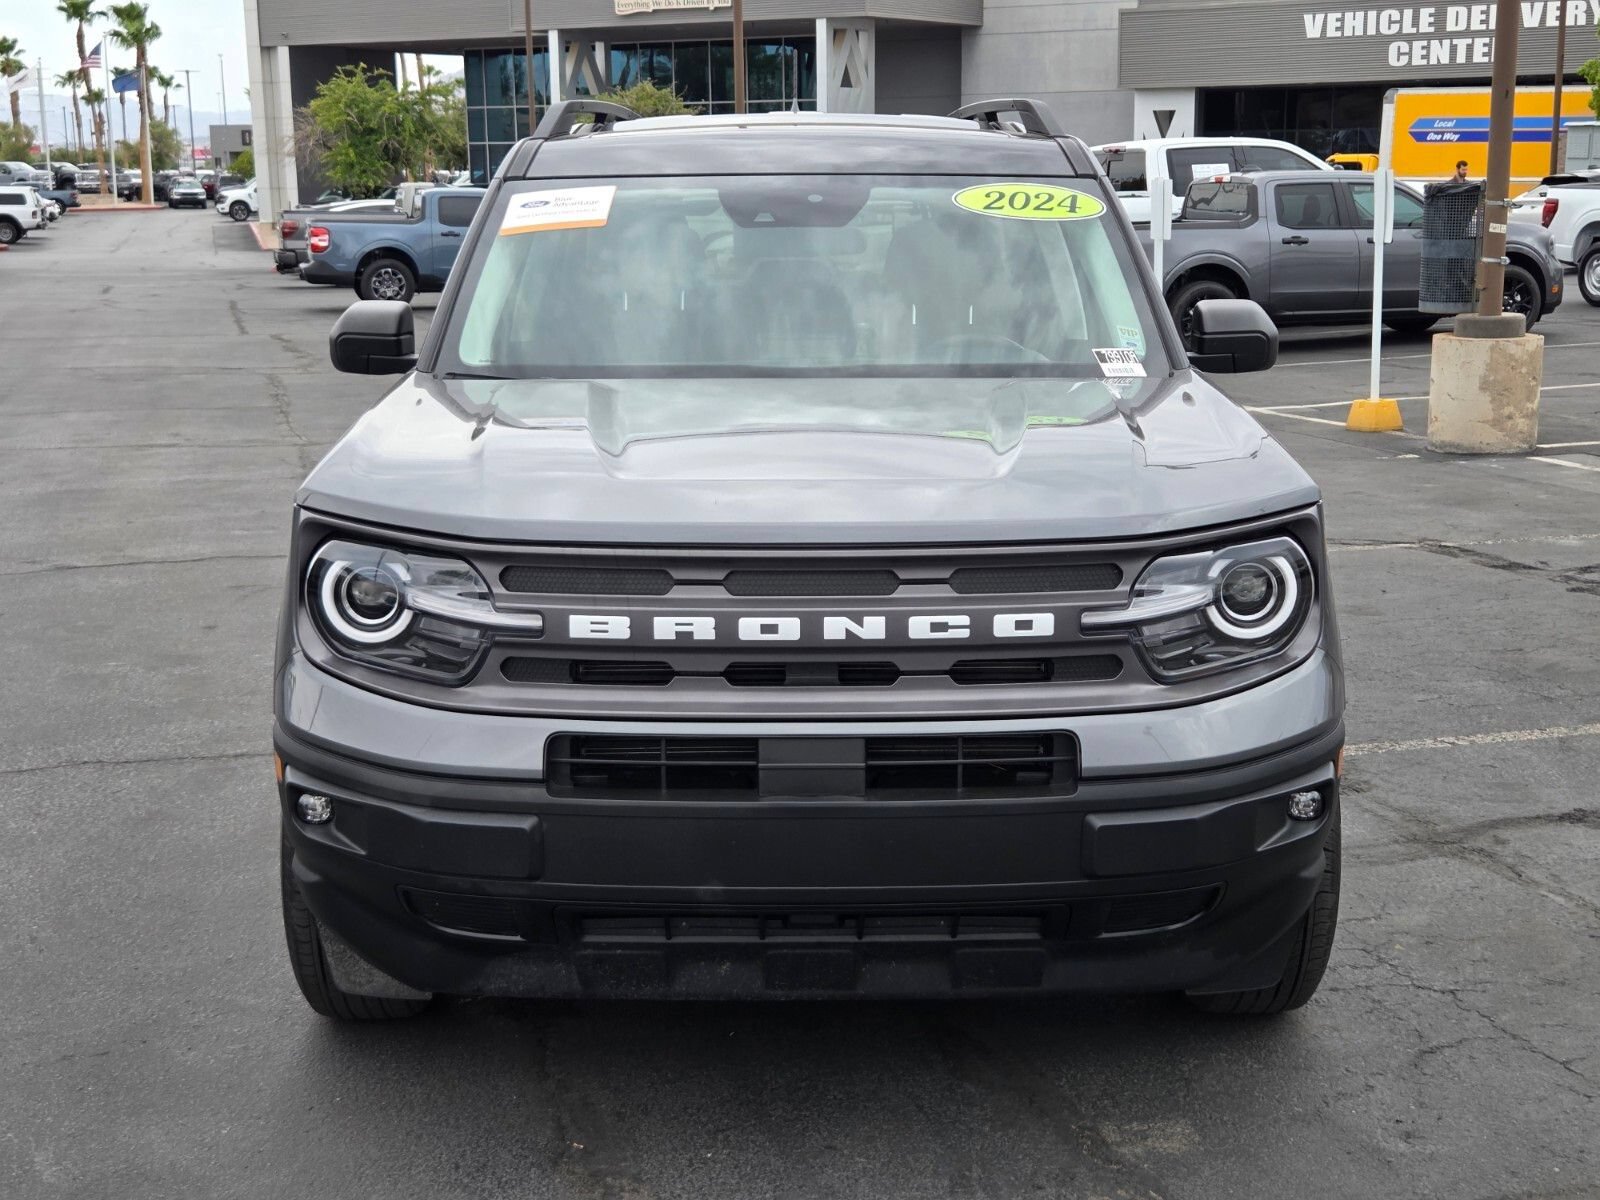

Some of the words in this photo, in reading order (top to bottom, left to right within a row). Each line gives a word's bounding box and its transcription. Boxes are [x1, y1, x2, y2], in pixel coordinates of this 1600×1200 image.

[617, 1, 650, 9] Everything
[1304, 7, 1435, 38] VEHICLE
[1446, 0, 1600, 31] DELVER
[1388, 37, 1495, 67] CENTE
[1434, 120, 1456, 128] Local
[1426, 132, 1442, 141] One
[1443, 132, 1460, 142] Way
[983, 190, 1081, 214] 2024
[569, 613, 1055, 641] BRONCO
